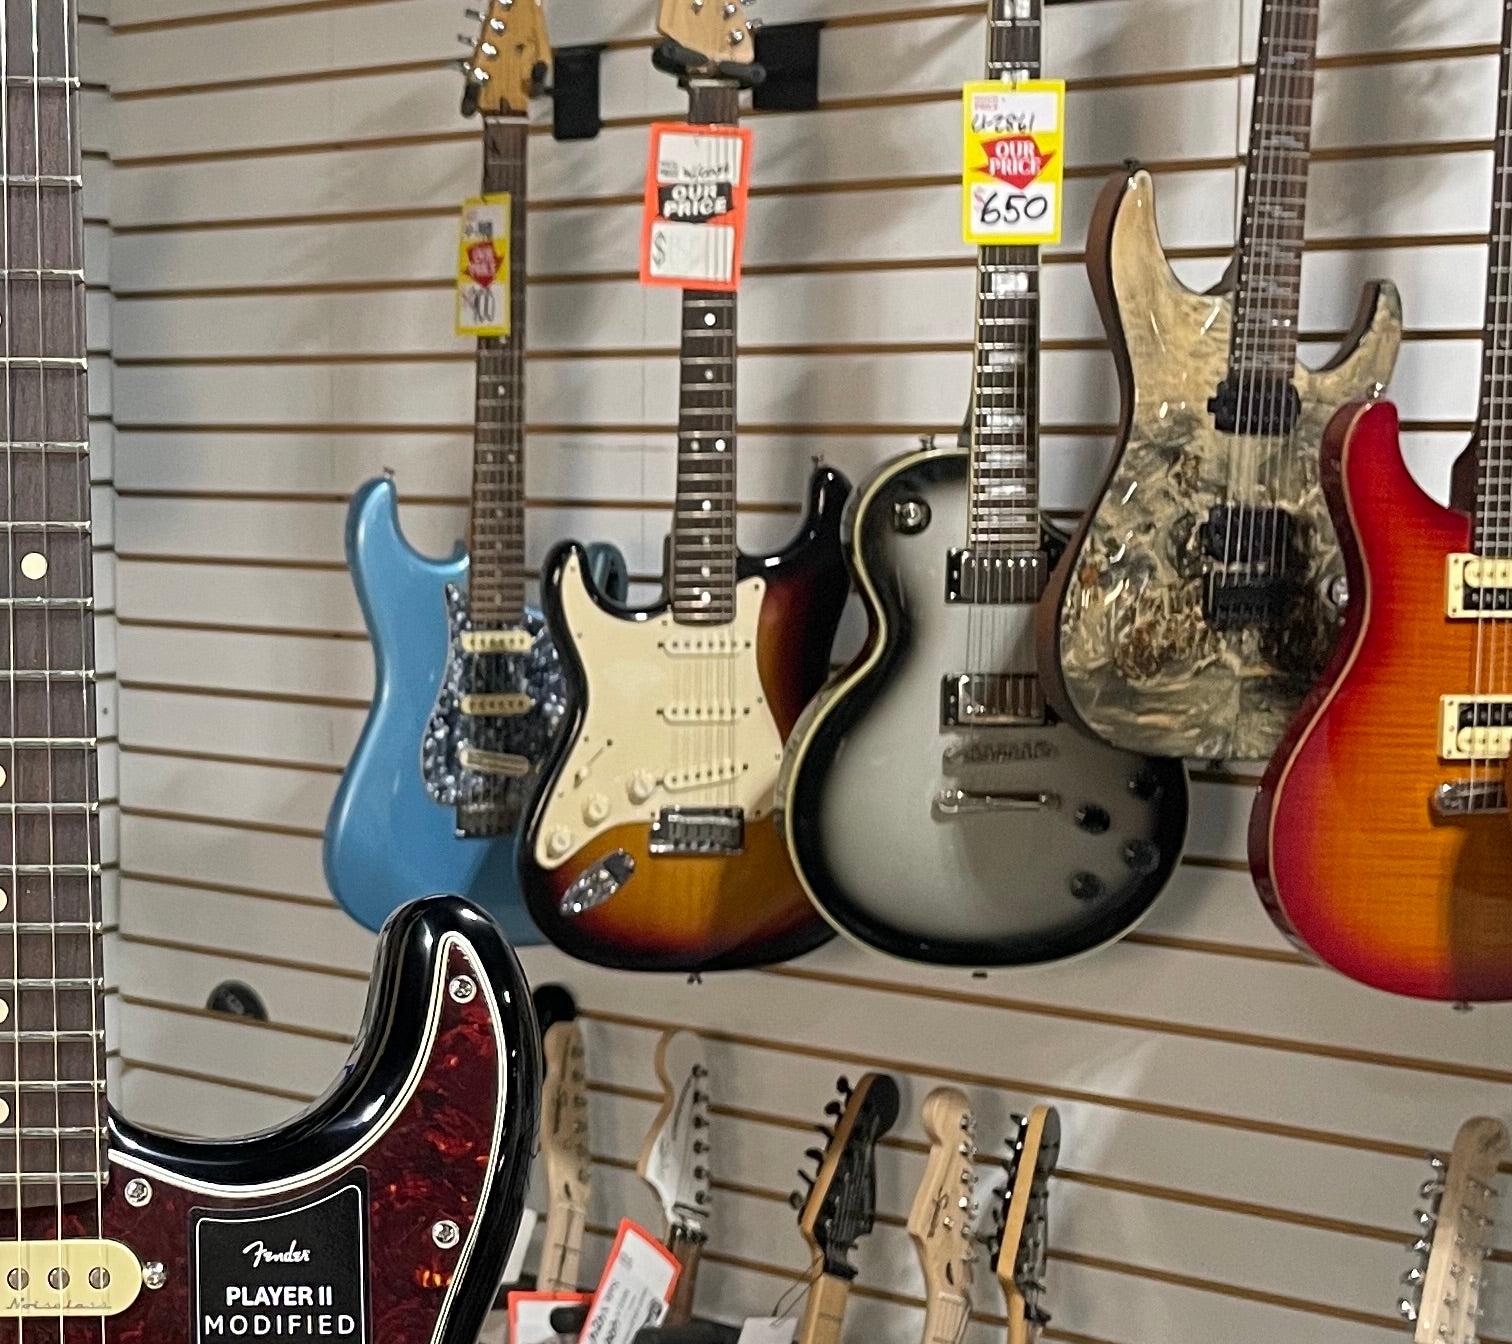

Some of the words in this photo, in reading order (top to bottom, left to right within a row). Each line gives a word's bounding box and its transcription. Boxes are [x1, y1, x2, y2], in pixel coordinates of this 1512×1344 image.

[995, 139, 1036, 157] OUR
[989, 156, 1042, 177] PRICE
[670, 182, 719, 203] OUR
[662, 195, 728, 218] PRICE
[651, 230, 667, 269] $
[242, 1239, 311, 1269] Fender
[5, 1296, 113, 1310] Noiseless
[225, 1286, 314, 1307] PLAYER
[318, 1286, 333, 1307] II
[204, 1314, 356, 1336] MODIFIED
